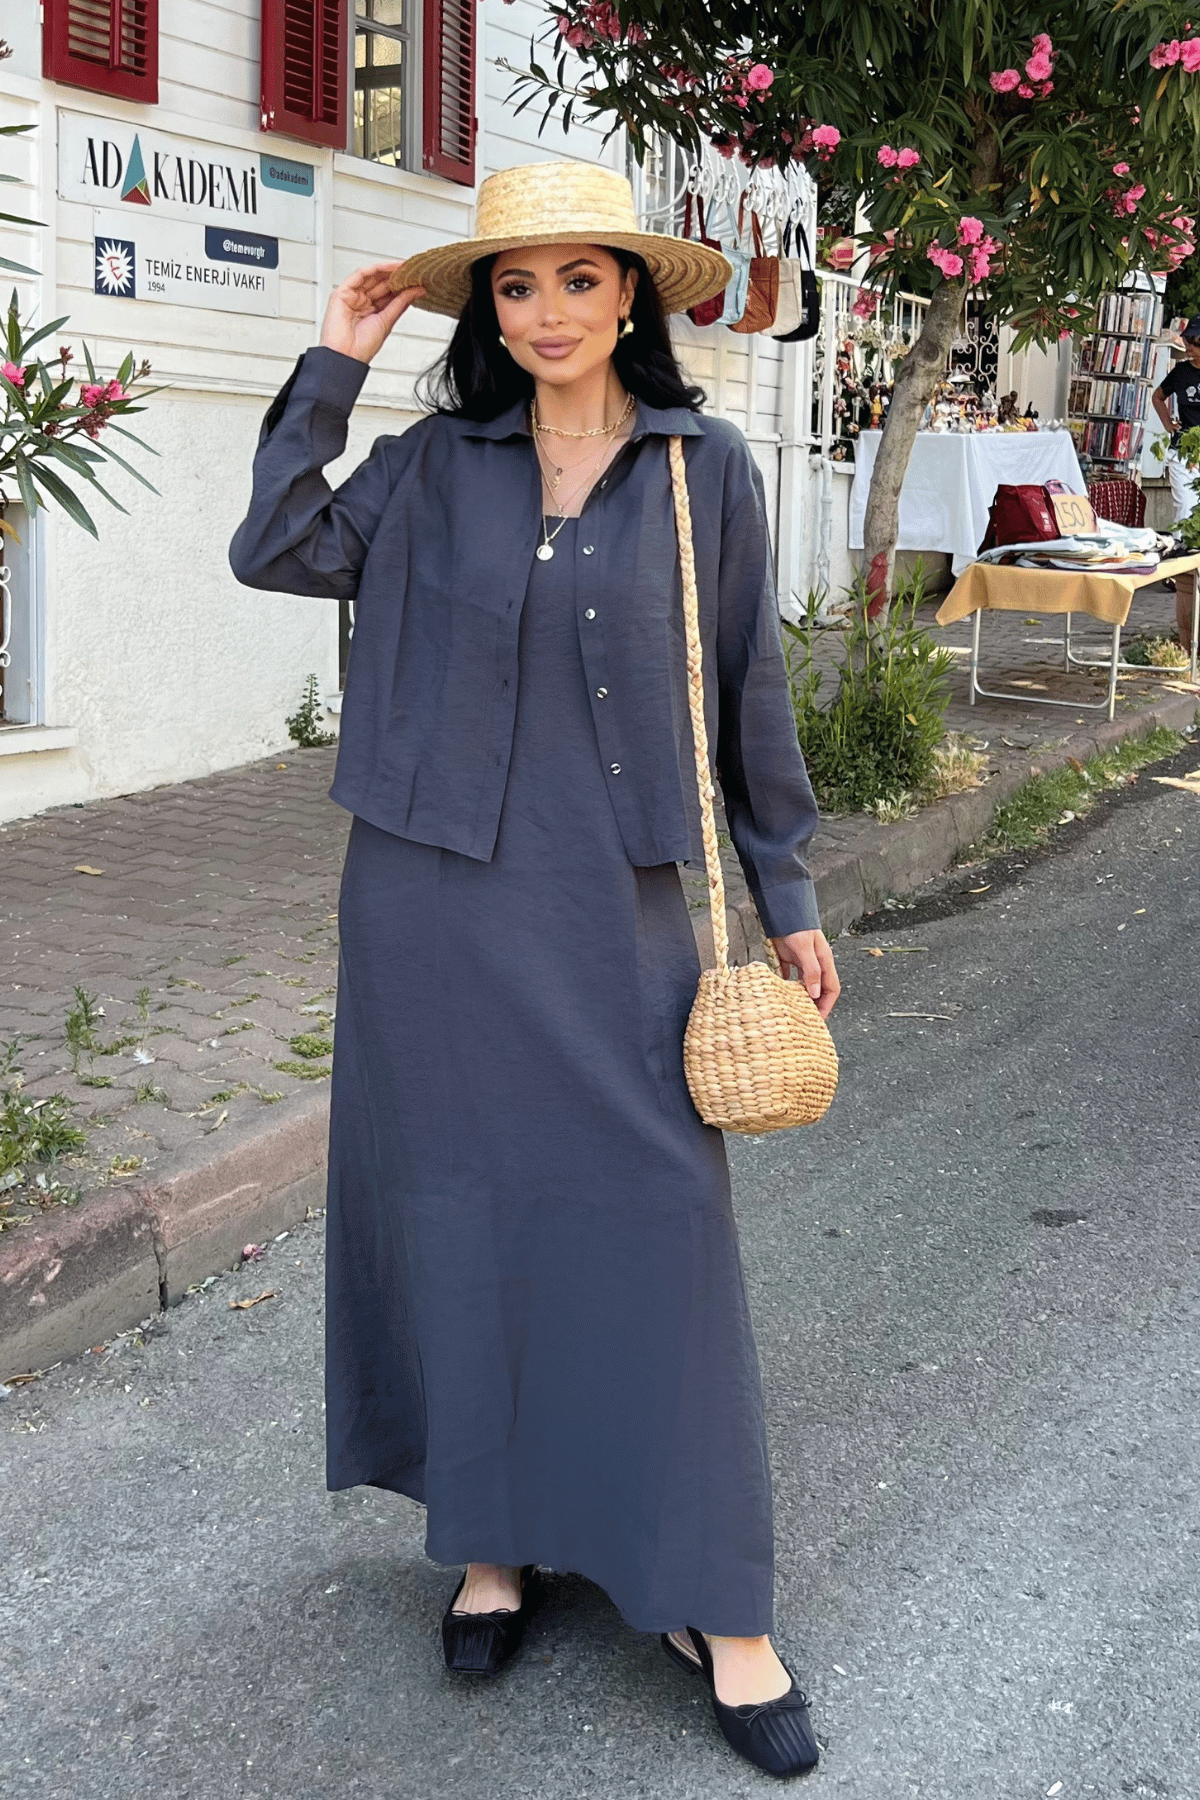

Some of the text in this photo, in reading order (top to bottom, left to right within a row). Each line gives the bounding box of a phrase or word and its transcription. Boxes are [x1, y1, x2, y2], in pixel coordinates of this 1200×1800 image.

[145, 258, 265, 292] TEMİZ ENERJİ VAKFI
[147, 280, 166, 293] 1994
[1053, 501, 1085, 528] 150
